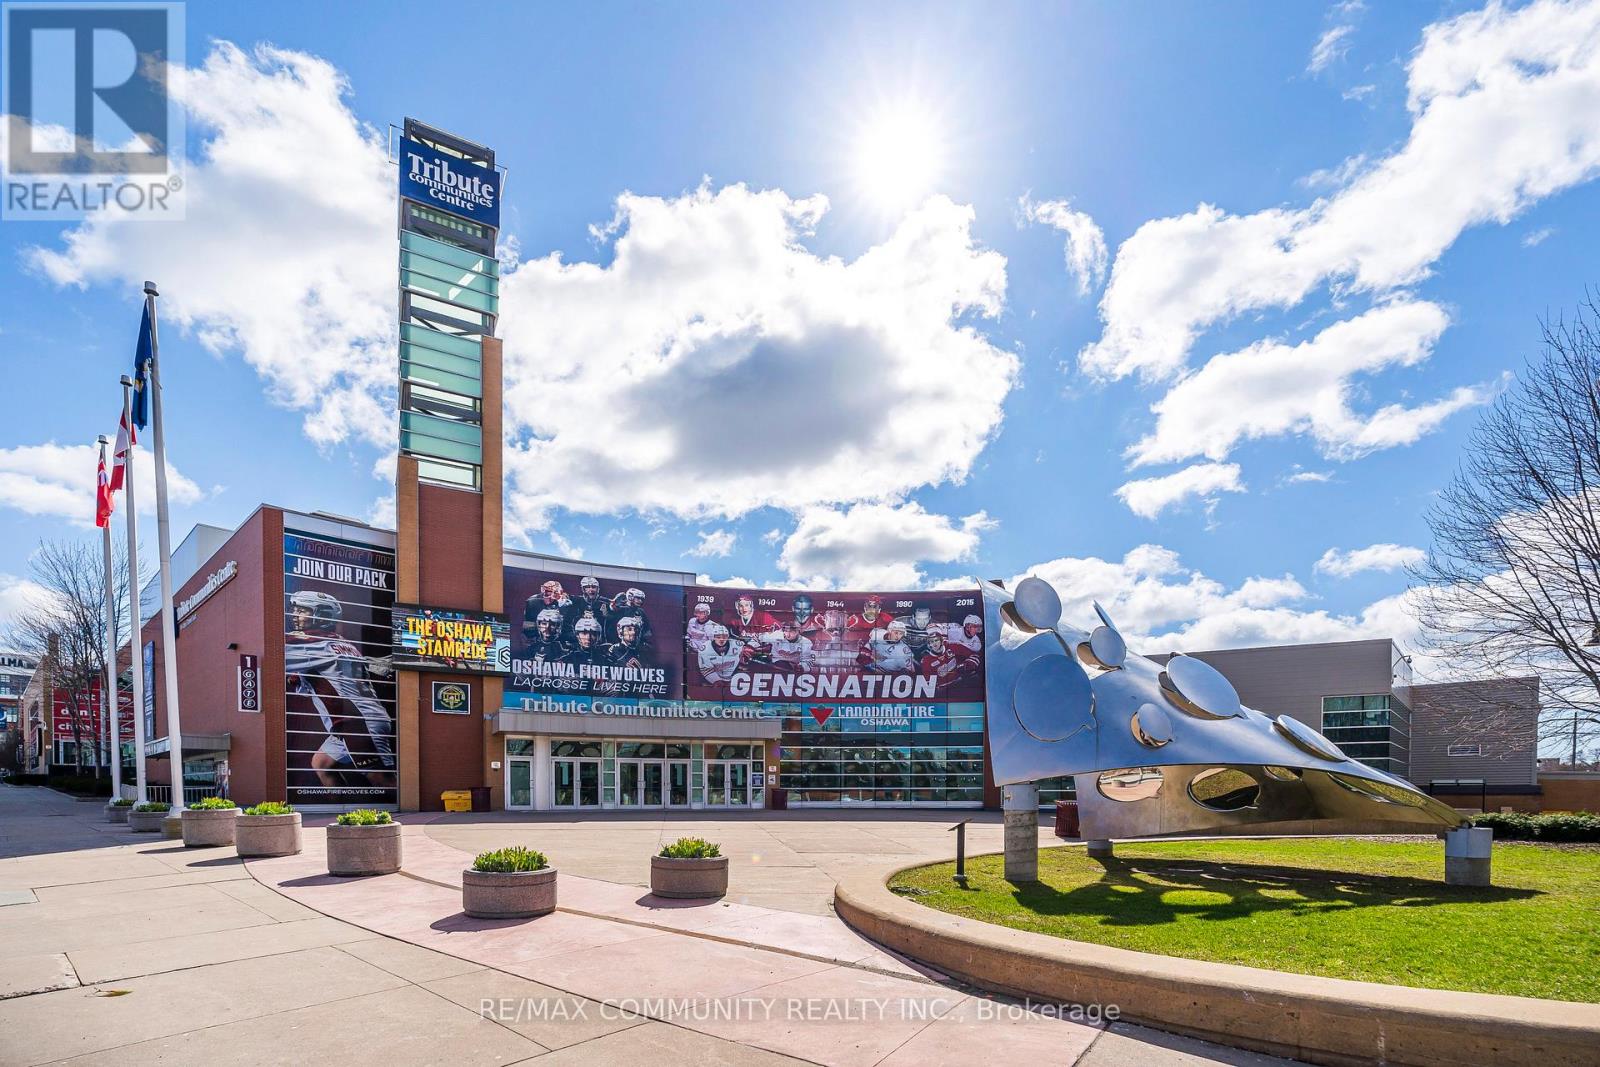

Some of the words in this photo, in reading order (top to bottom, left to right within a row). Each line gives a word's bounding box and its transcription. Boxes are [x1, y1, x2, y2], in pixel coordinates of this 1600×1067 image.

[407, 152, 494, 199] Tribute
[408, 172, 493, 208] communities
[429, 187, 475, 211] Centre
[293, 558, 324, 578] JOIN
[328, 564, 352, 583] OUR
[355, 568, 387, 588] PACK
[697, 595, 715, 603] 1939
[758, 598, 776, 606] 1940
[406, 617, 433, 637] THE
[436, 621, 493, 642] OSHAWA
[417, 638, 487, 660] STAMPEDE
[512, 659, 575, 678] OSHAWA
[579, 664, 665, 683] FIREWOLVES
[513, 676, 589, 690] LACROSSE
[593, 682, 630, 693] LIVES
[633, 683, 668, 694] HERE
[729, 673, 938, 698] GENSNATION
[520, 695, 588, 714] Tribute
[591, 701, 707, 719] Communities
[710, 705, 766, 719] Centre
[838, 706, 903, 717] CANADIAN
[906, 706, 935, 717] TIRE
